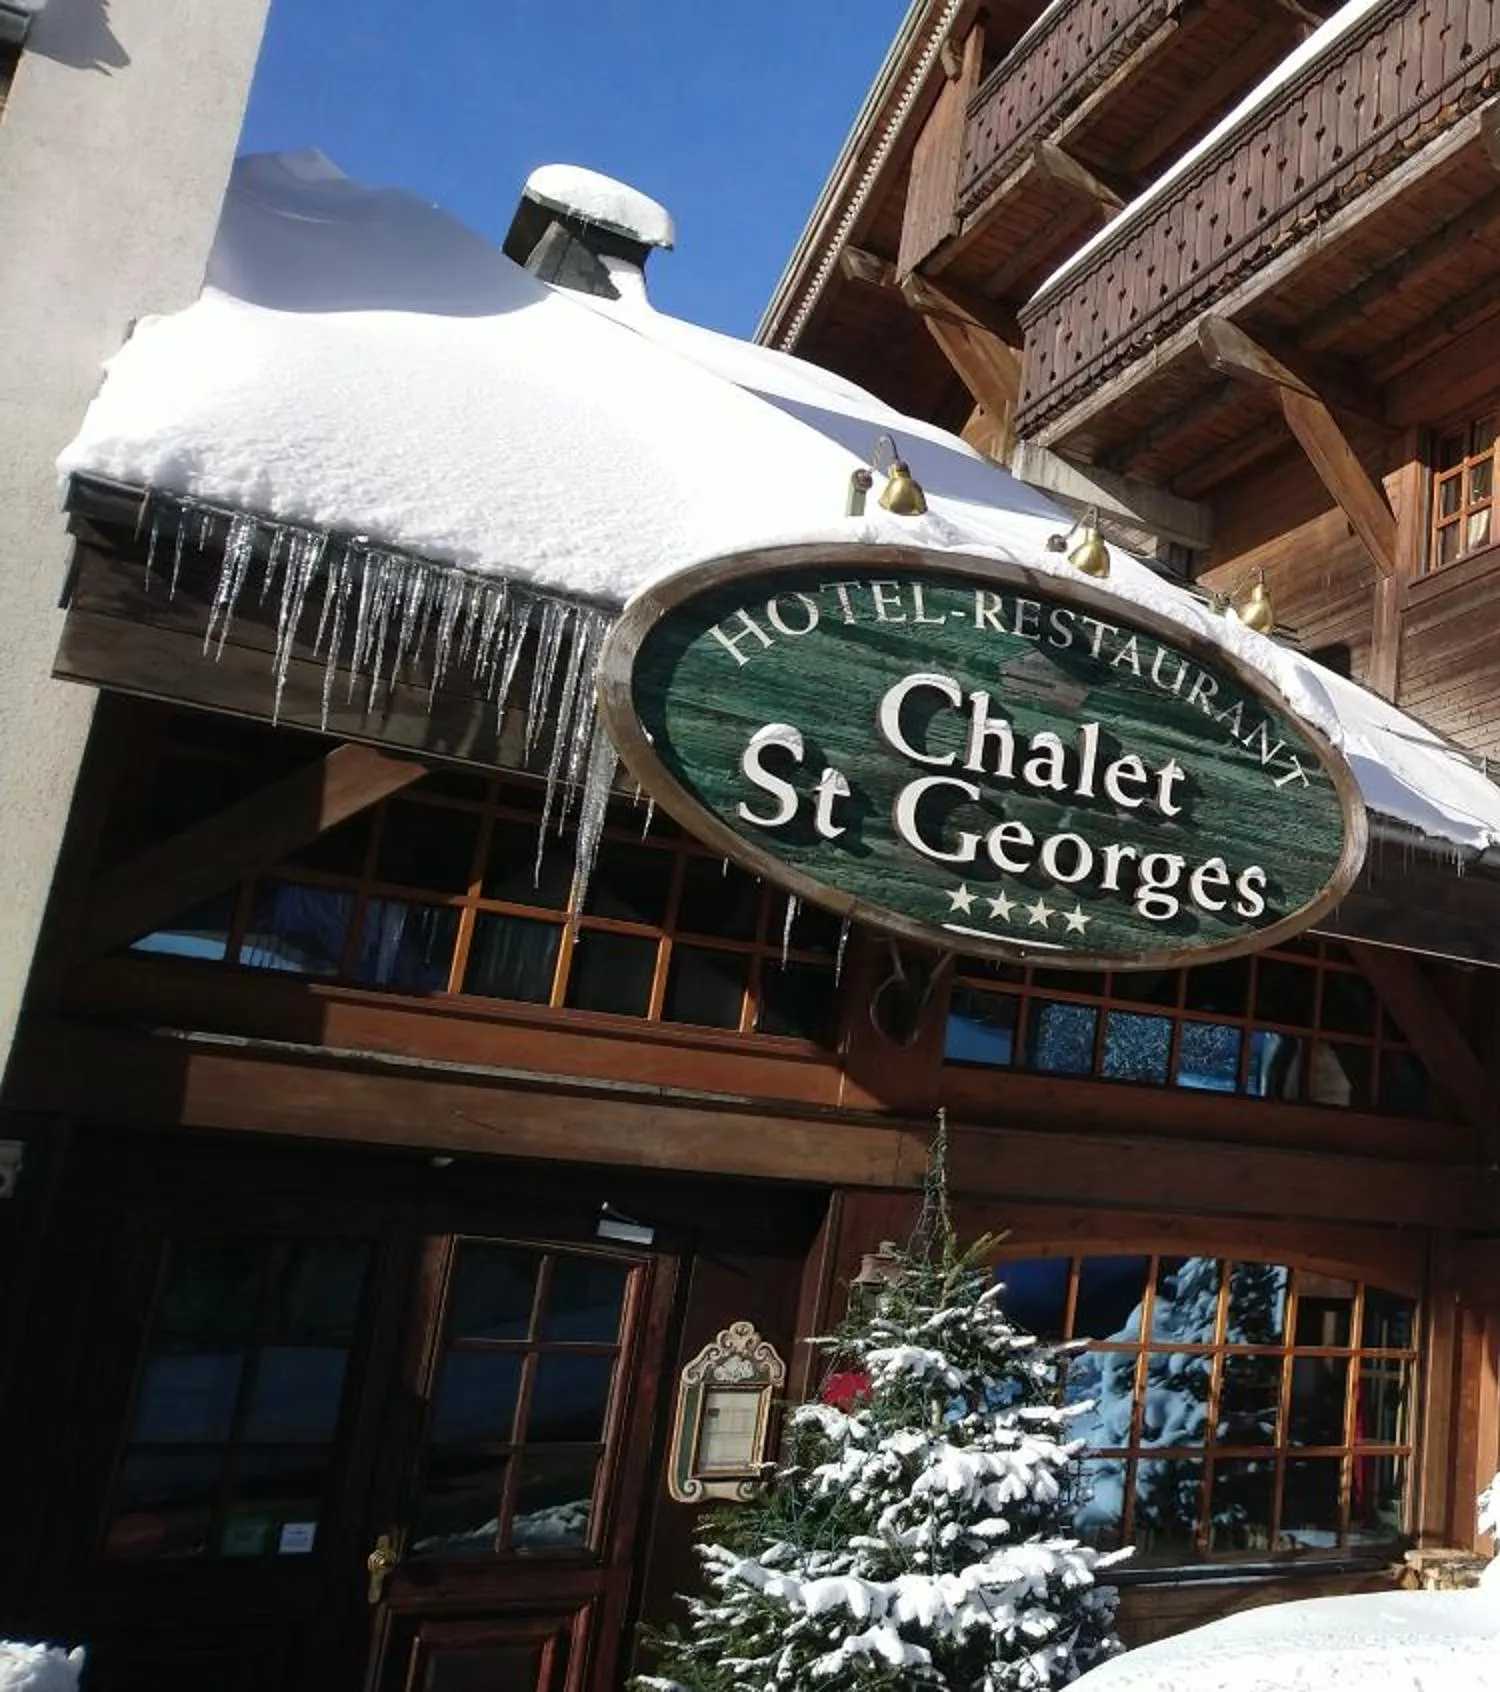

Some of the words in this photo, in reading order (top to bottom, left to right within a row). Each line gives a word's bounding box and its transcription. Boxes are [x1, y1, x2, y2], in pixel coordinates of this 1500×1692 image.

[709, 579, 1310, 792] HOTEL-RESTAURANT
[877, 672, 1185, 817] Chalet
[737, 723, 848, 839] St
[893, 775, 1268, 920] Georges
